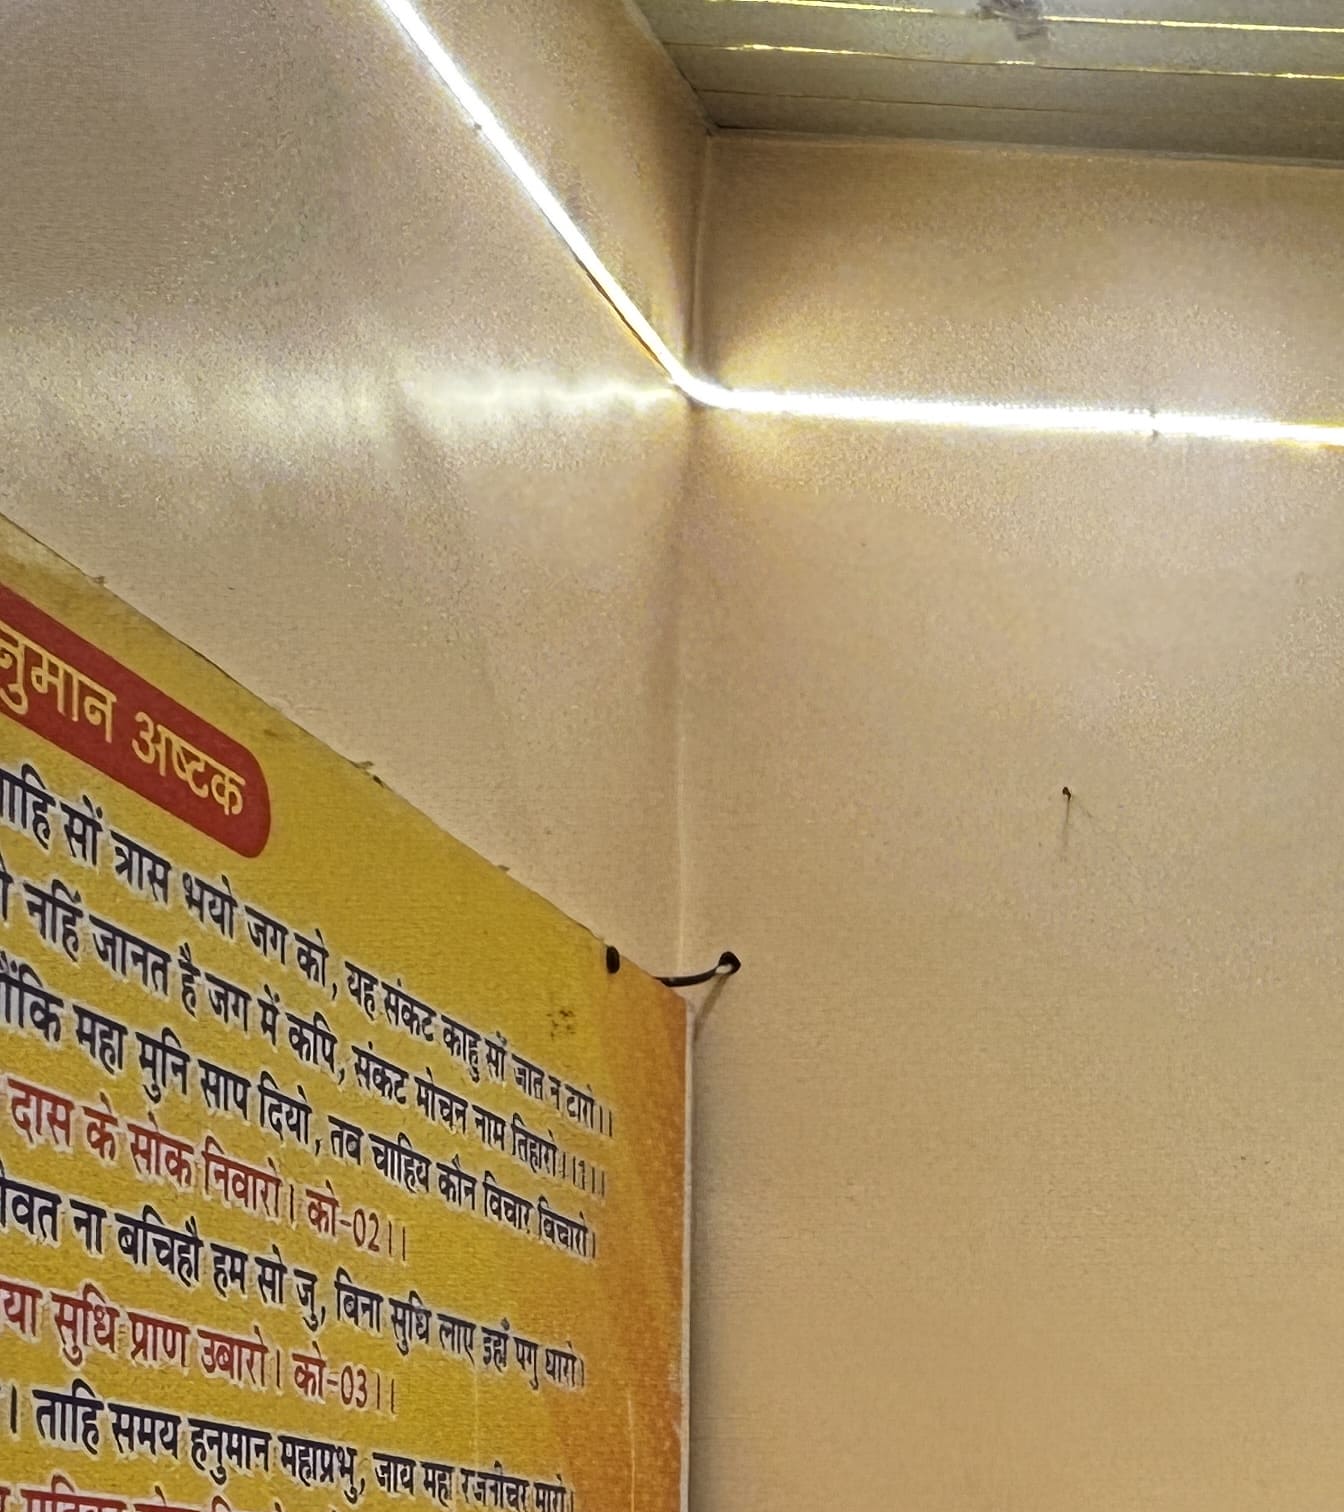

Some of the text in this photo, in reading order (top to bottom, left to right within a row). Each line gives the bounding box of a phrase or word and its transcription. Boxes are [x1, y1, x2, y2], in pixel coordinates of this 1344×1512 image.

[132, 711, 245, 816] अष्टक
[61, 794, 103, 867] सों
[110, 829, 172, 905] त्रास
[182, 872, 238, 940] भयो
[244, 905, 289, 966] जग
[343, 960, 379, 1021] यह
[380, 978, 437, 1042] संकट
[440, 1014, 482, 1084] काहु
[510, 1053, 545, 1101] जात
[88, 914, 172, 996] जानत
[177, 942, 201, 1018] है
[204, 972, 252, 1033] जग
[256, 983, 281, 1047] में
[350, 1040, 409, 1105] संकट
[413, 1066, 469, 1135] मोचन
[471, 1104, 506, 1152] नाम
[7, 1077, 75, 1147] दास
[81, 1091, 119, 1161] के
[126, 1110, 194, 1187] सोक
[72, 1004, 129, 1075] महा
[134, 1026, 191, 1105] मुनि
[196, 1058, 251, 1121] साप
[435, 1153, 478, 1211] कौन
[126, 1311, 191, 1368] प्राण
[187, 1418, 273, 1486] हनुमान
